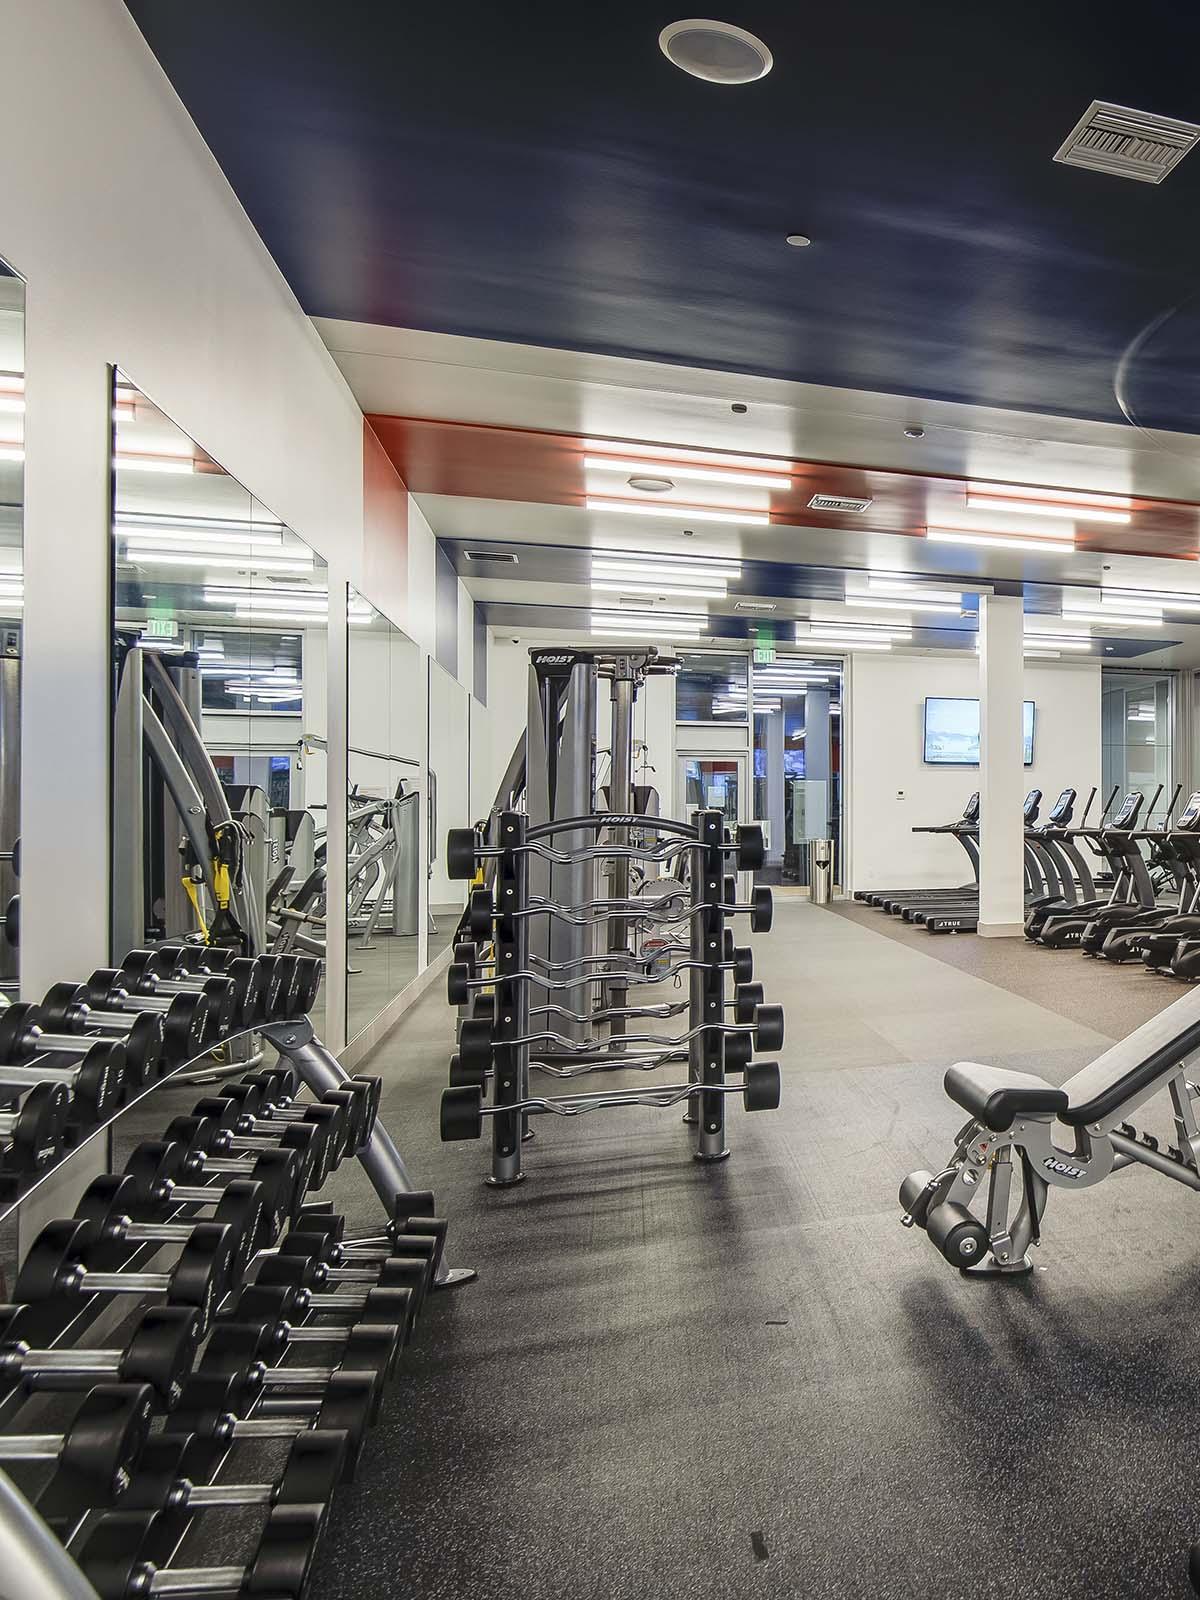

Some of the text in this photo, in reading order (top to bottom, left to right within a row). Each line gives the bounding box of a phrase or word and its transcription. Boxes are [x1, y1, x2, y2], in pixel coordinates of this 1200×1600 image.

[535, 656, 575, 664] HOIST
[600, 816, 639, 824] HOIST
[1044, 1158, 1088, 1178] HOIST
